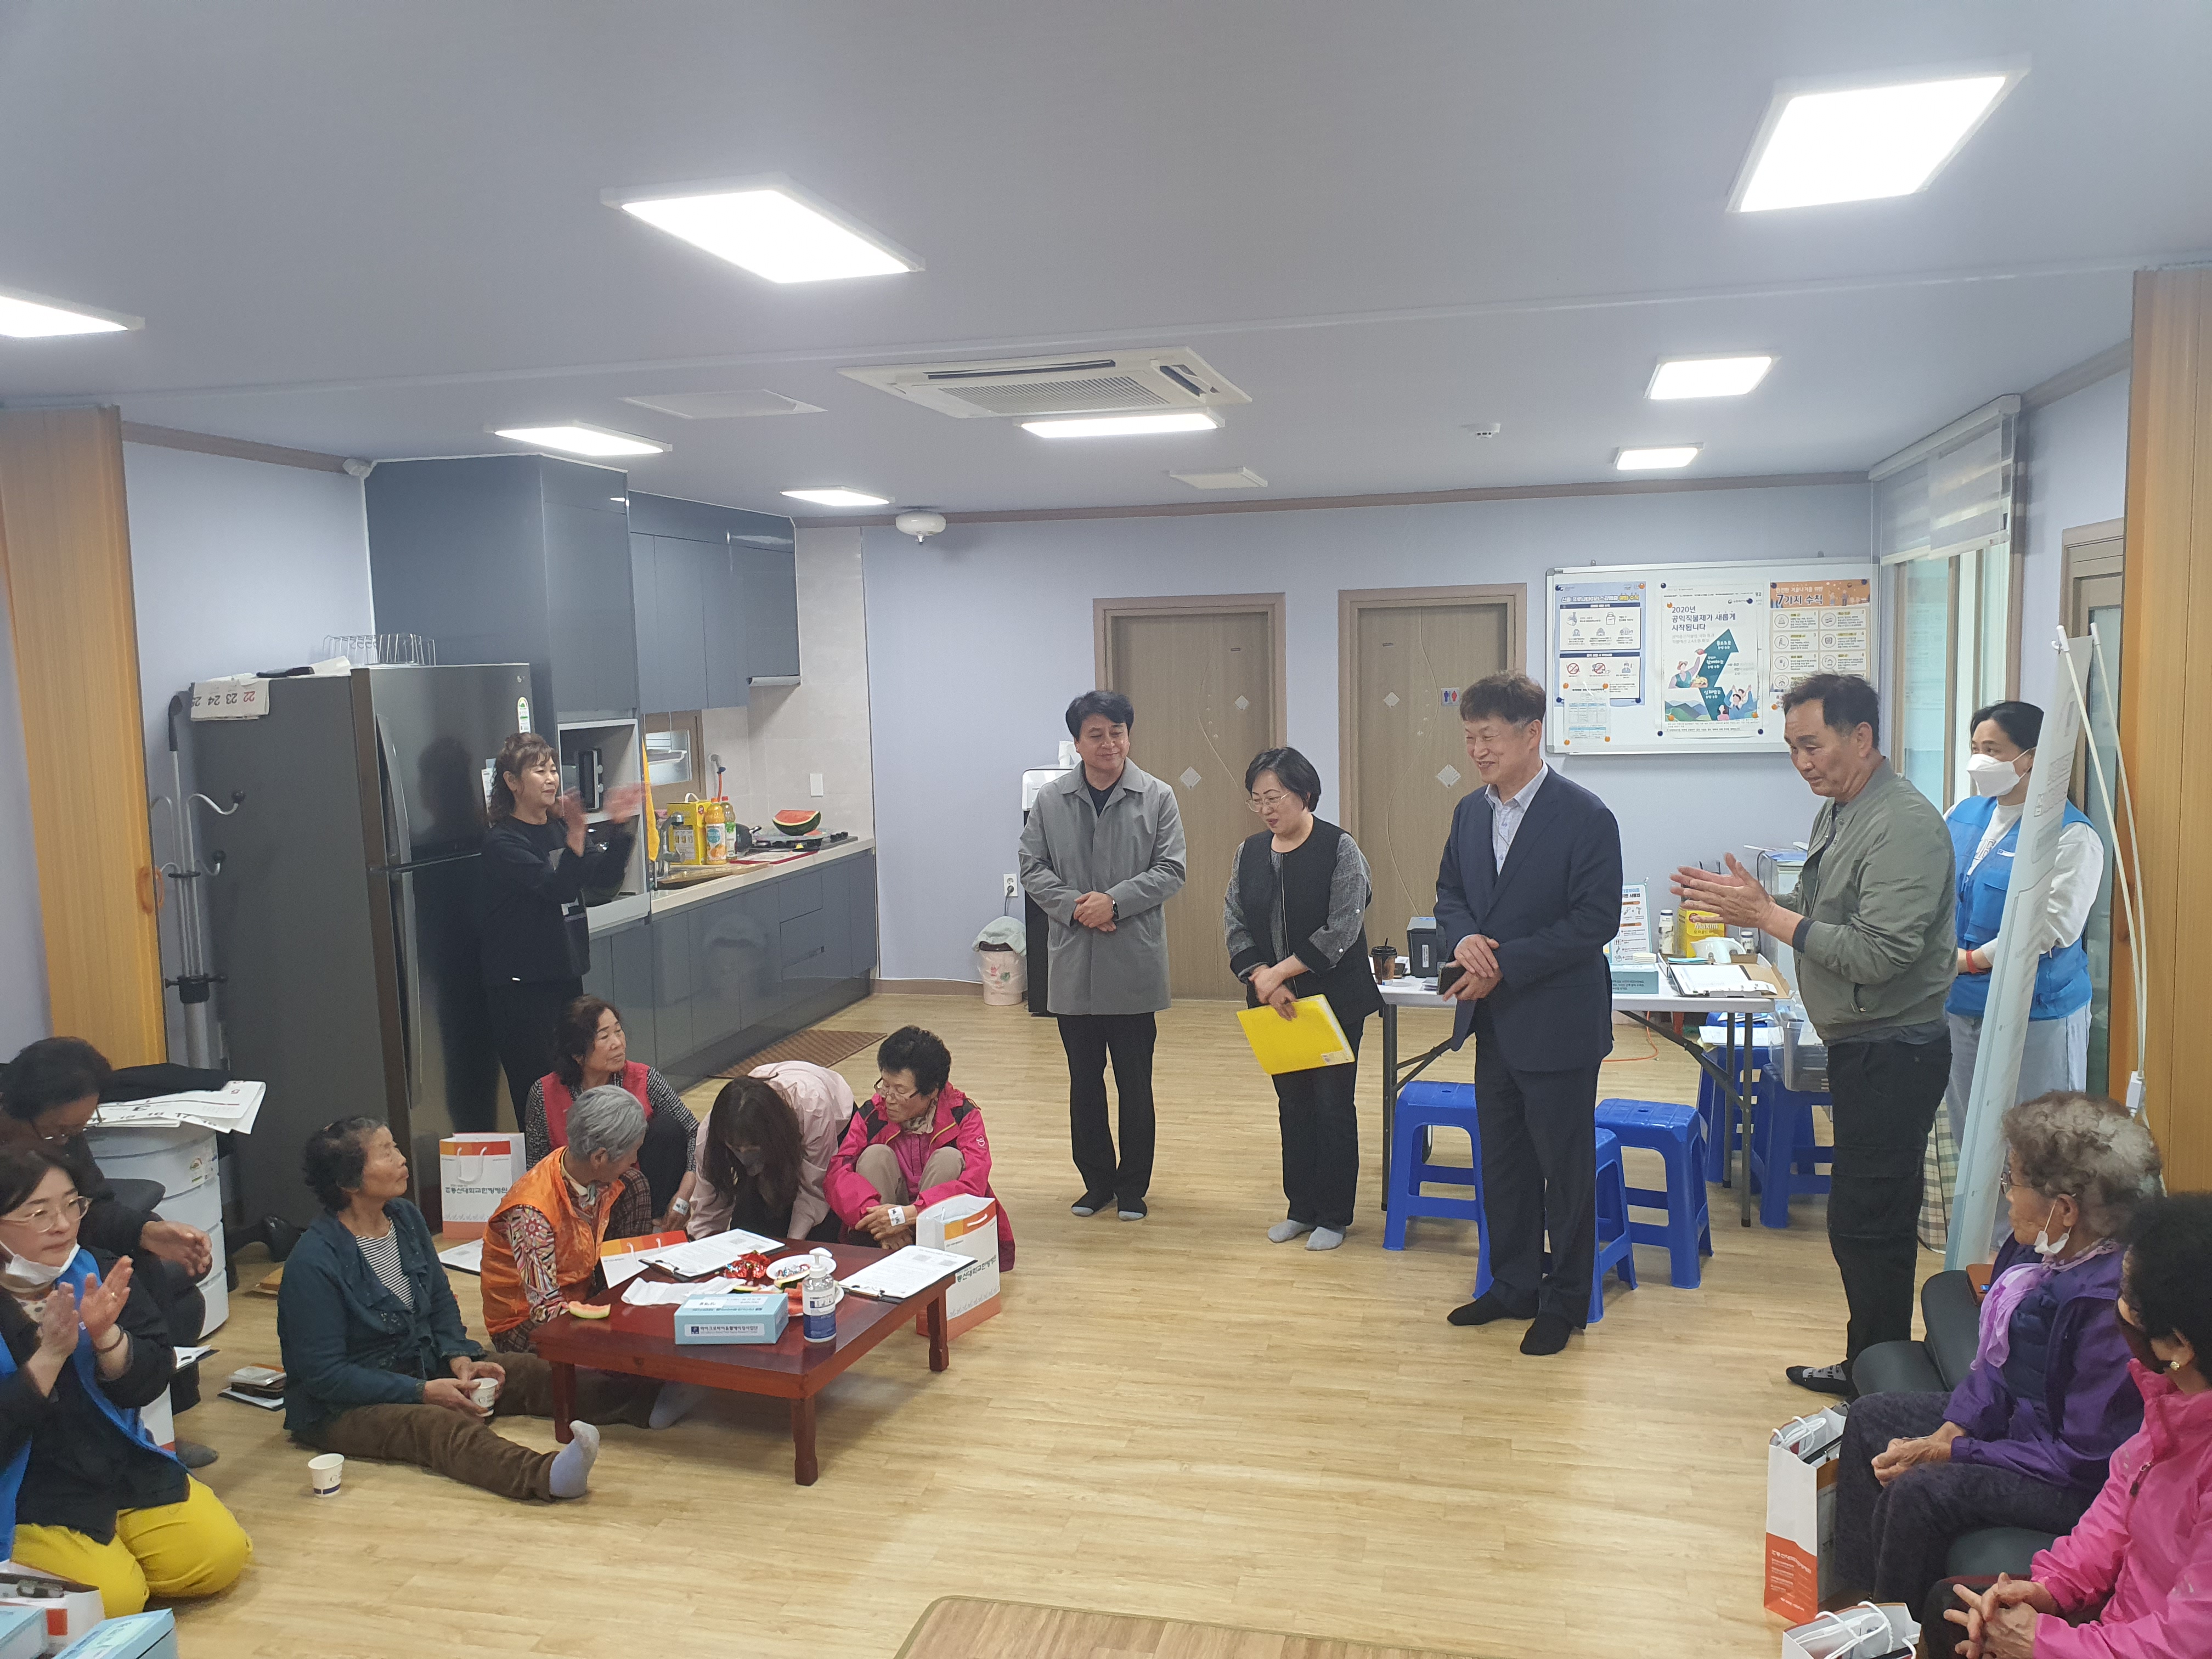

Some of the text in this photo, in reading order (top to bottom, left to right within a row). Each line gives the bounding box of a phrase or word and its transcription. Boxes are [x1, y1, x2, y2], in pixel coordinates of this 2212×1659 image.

[1776, 594, 1823, 605] 7가지 수칙
[1672, 613, 1736, 623] 공익직불제가 새롭게
[1672, 623, 1706, 631] 시작됩니다
[207, 695, 221, 706] 24
[225, 693, 238, 704] 23
[243, 691, 256, 702] 22
